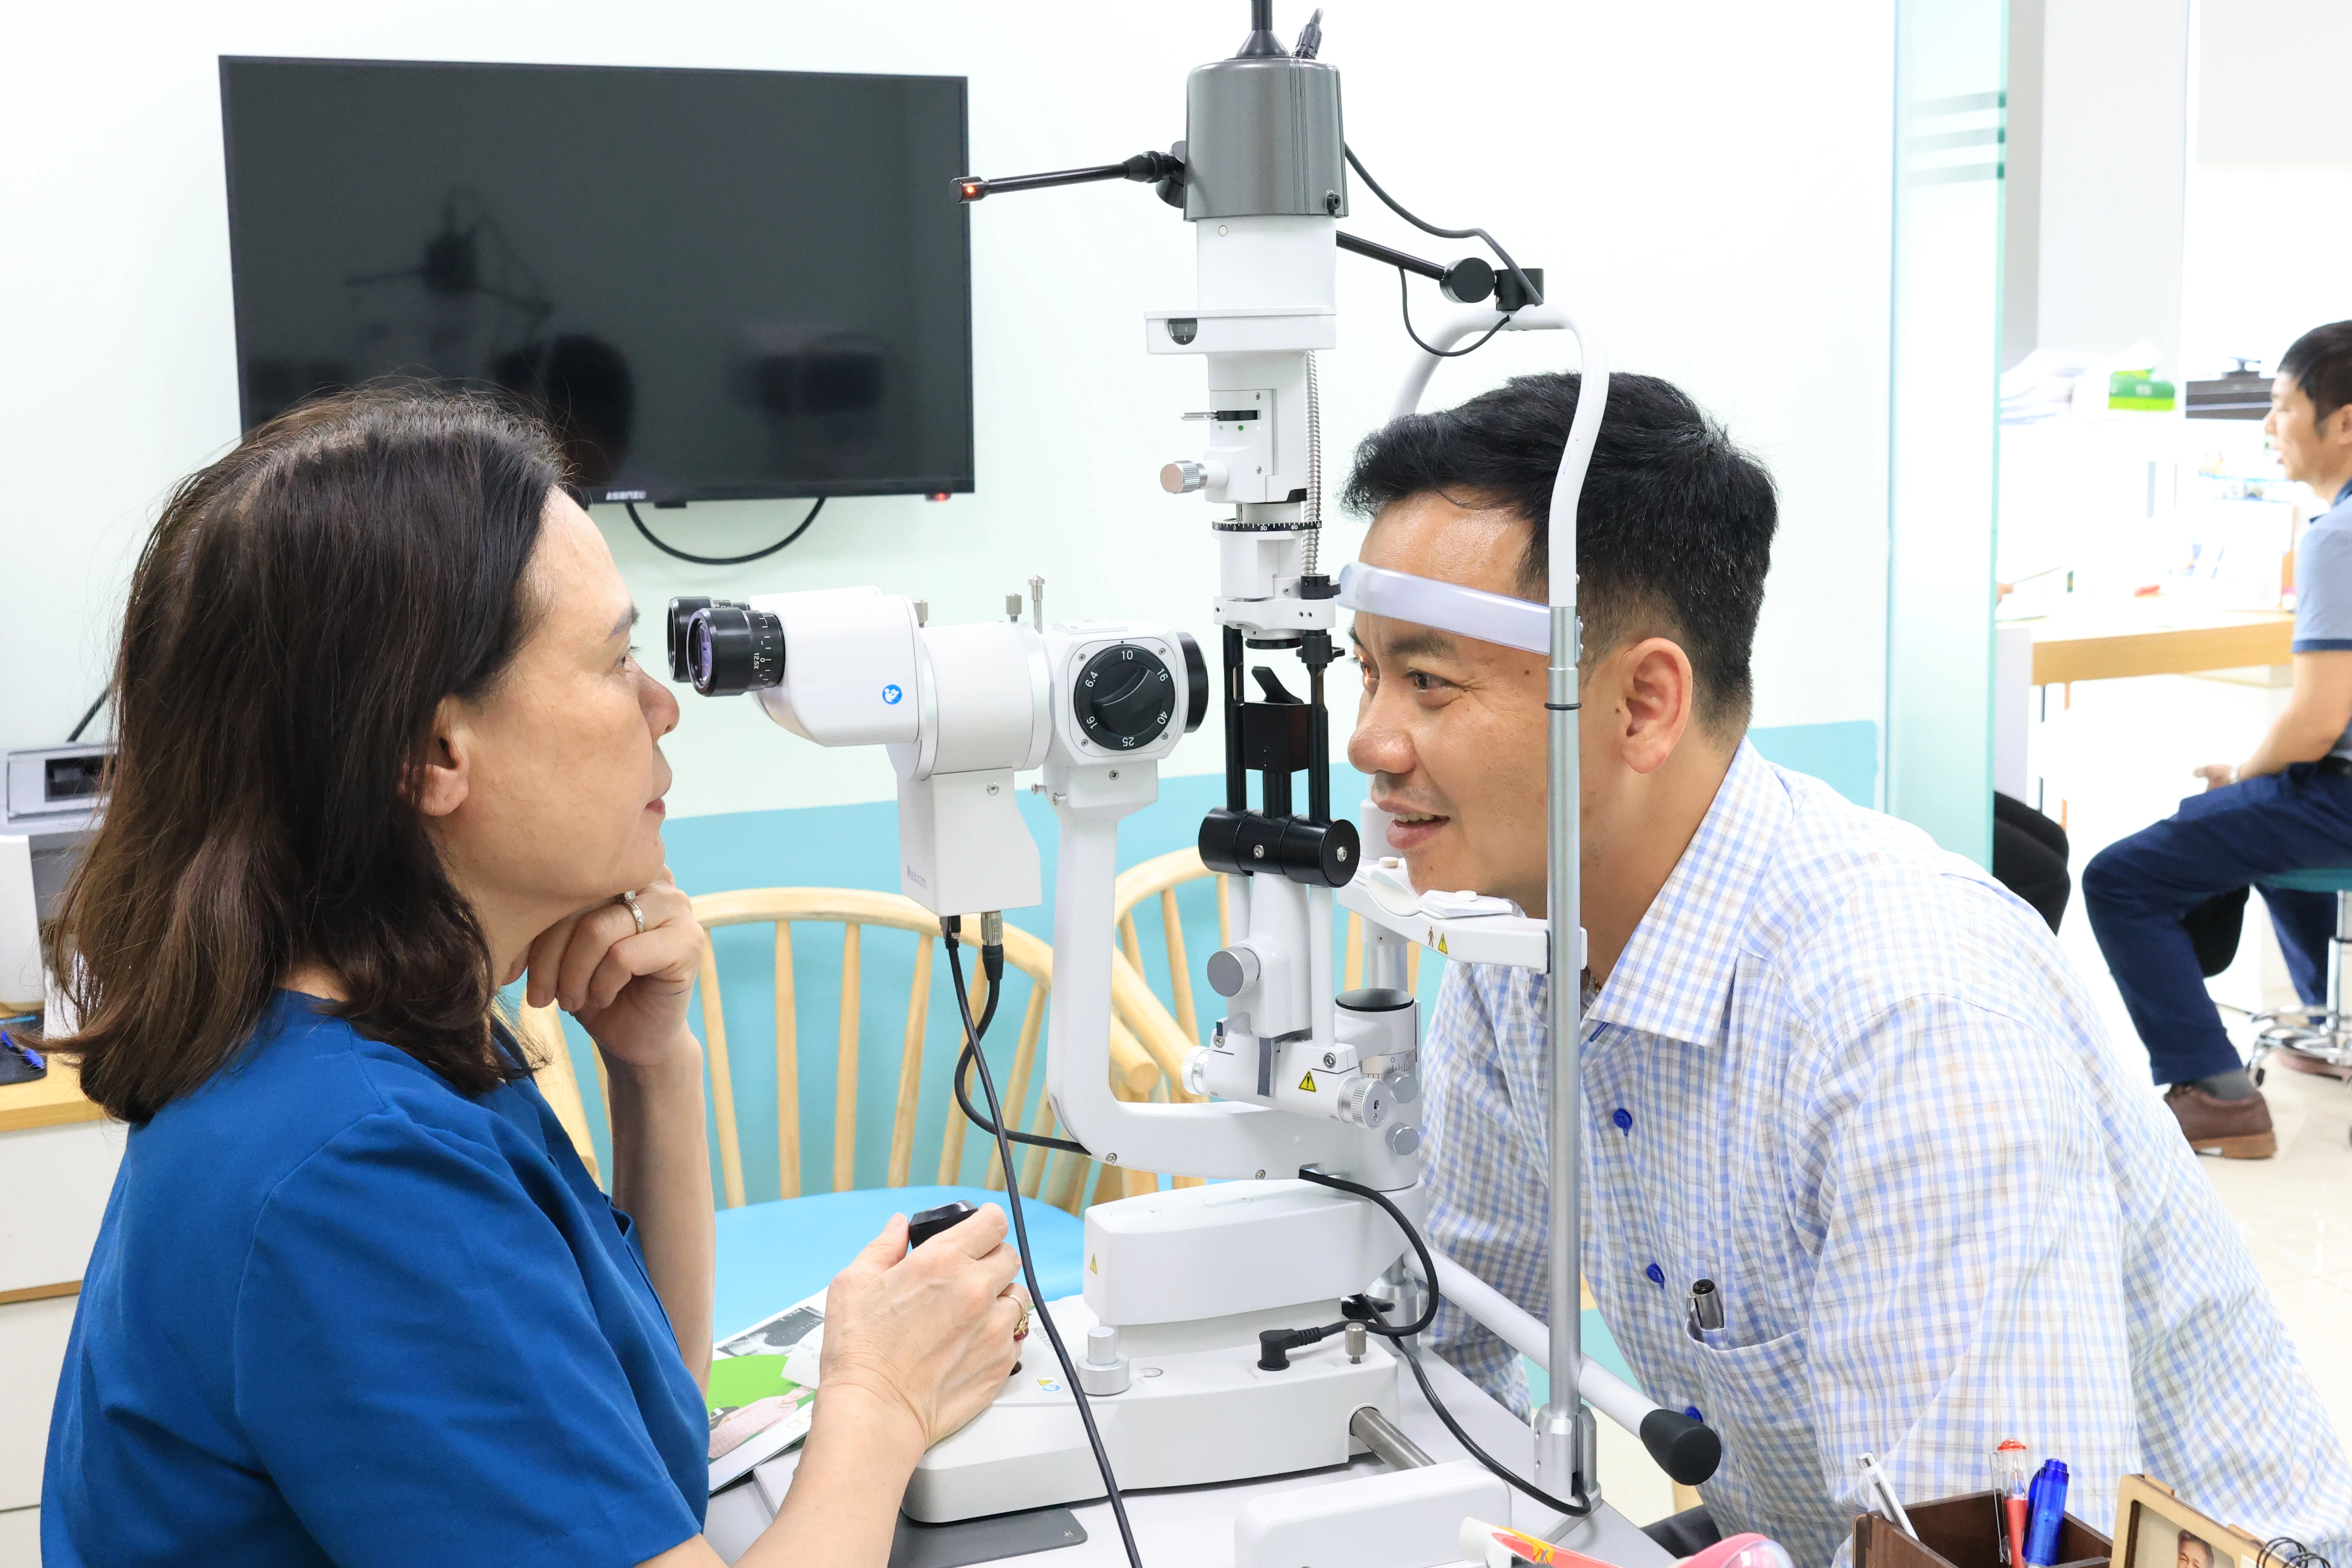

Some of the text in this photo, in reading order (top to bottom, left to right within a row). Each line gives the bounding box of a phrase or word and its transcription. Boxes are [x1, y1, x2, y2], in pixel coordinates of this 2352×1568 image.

[1121, 650, 1133, 660] 10
[1085, 671, 1098, 688] 6.4
[1157, 668, 1168, 682] 16
[1086, 716, 1098, 729] 16
[1157, 710, 1168, 725] 40
[1122, 737, 1134, 747] 25
[907, 864, 927, 889] Rexxam
